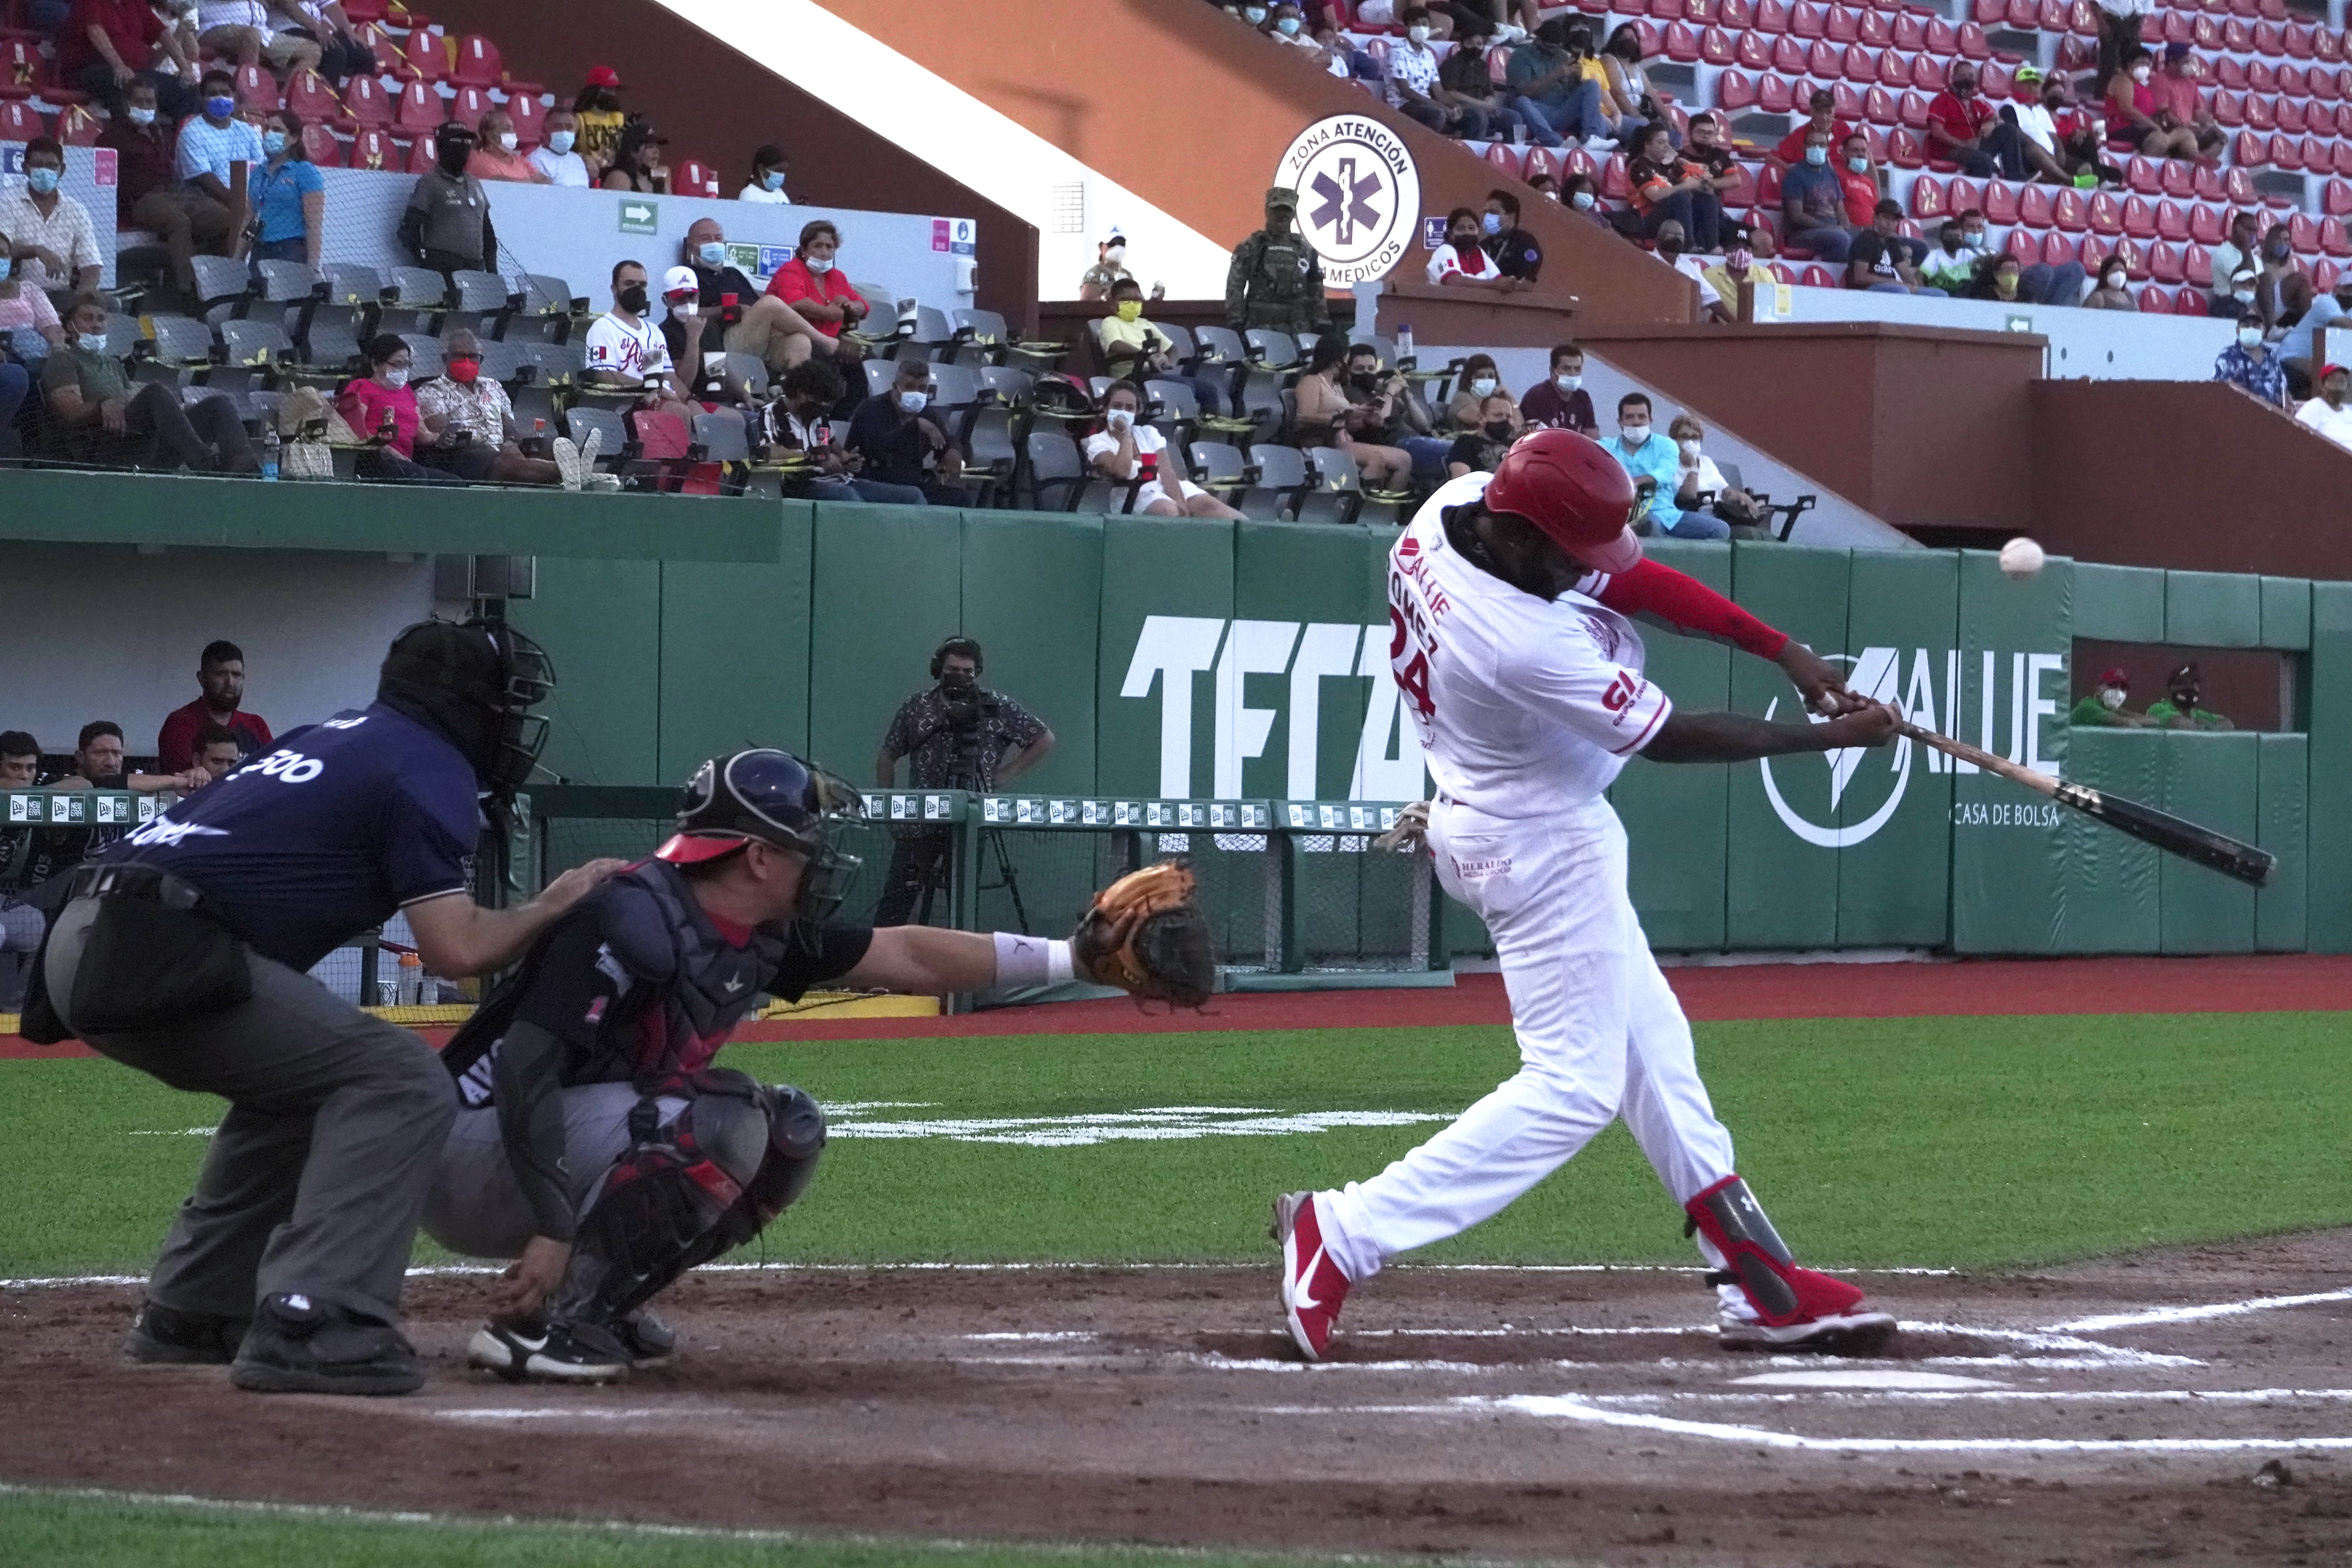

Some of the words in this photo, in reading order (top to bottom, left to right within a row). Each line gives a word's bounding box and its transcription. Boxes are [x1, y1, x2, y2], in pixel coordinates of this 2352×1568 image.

[1290, 129, 1330, 170] ZONA
[1335, 122, 1408, 175] ATENCIÓN
[1949, 803, 1988, 825] CASA
[1993, 804, 2010, 825] DE
[2014, 804, 2059, 827] BOLSA
